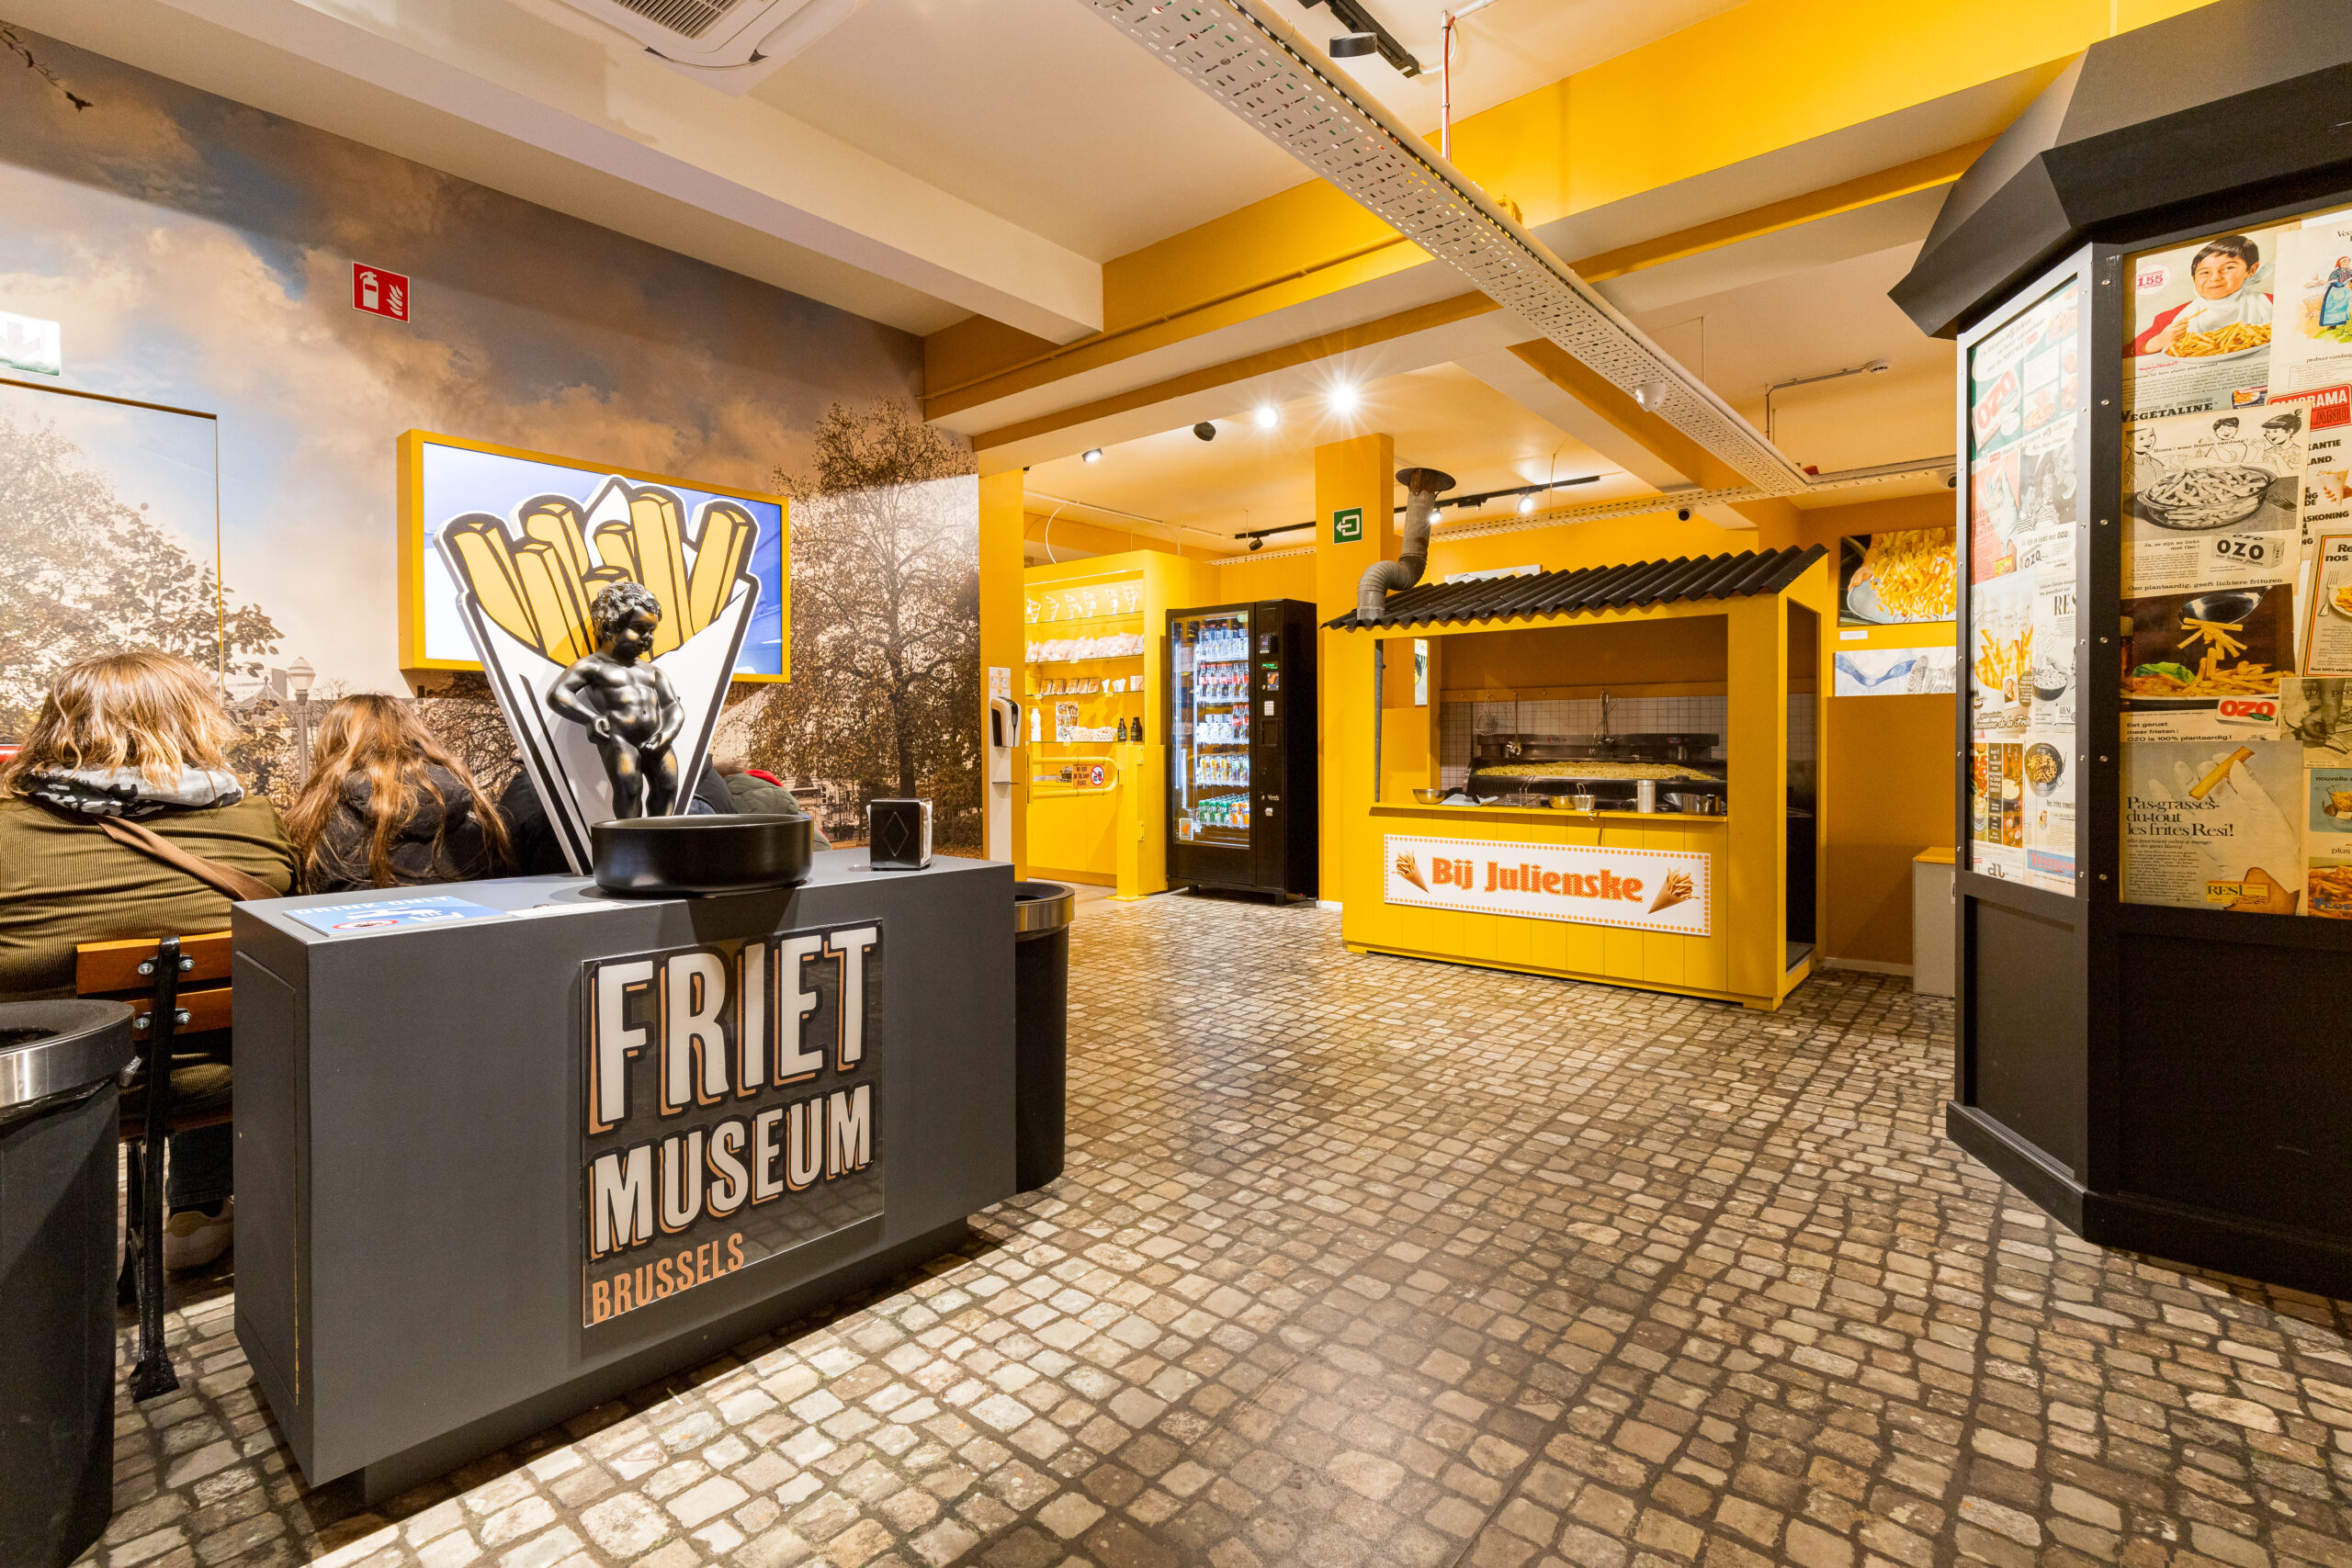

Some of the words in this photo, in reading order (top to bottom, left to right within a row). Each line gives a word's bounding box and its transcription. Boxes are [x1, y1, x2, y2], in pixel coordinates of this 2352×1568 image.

[1976, 369, 2017, 431] OZO
[2216, 539, 2265, 560] OZO
[2194, 581, 2214, 589] geeft
[2215, 579, 2248, 587] lichtere
[2250, 577, 2283, 586] frituren
[2219, 699, 2277, 718] OZO
[2127, 796, 2221, 813] Pas-grasses-
[2126, 809, 2183, 823] du-tout
[2127, 822, 2147, 836] les
[2150, 822, 2192, 837] frites
[2192, 822, 2234, 837] Resi!
[2331, 847, 2351, 855] plus
[1431, 856, 1474, 891] Bij
[1485, 862, 1644, 904] Julienske
[293, 902, 380, 916] DRINK
[388, 896, 450, 907] ONLY
[588, 927, 878, 1135] FRIET
[589, 1085, 874, 1259] MUSEUM
[592, 1233, 745, 1324] BRUSSELS
